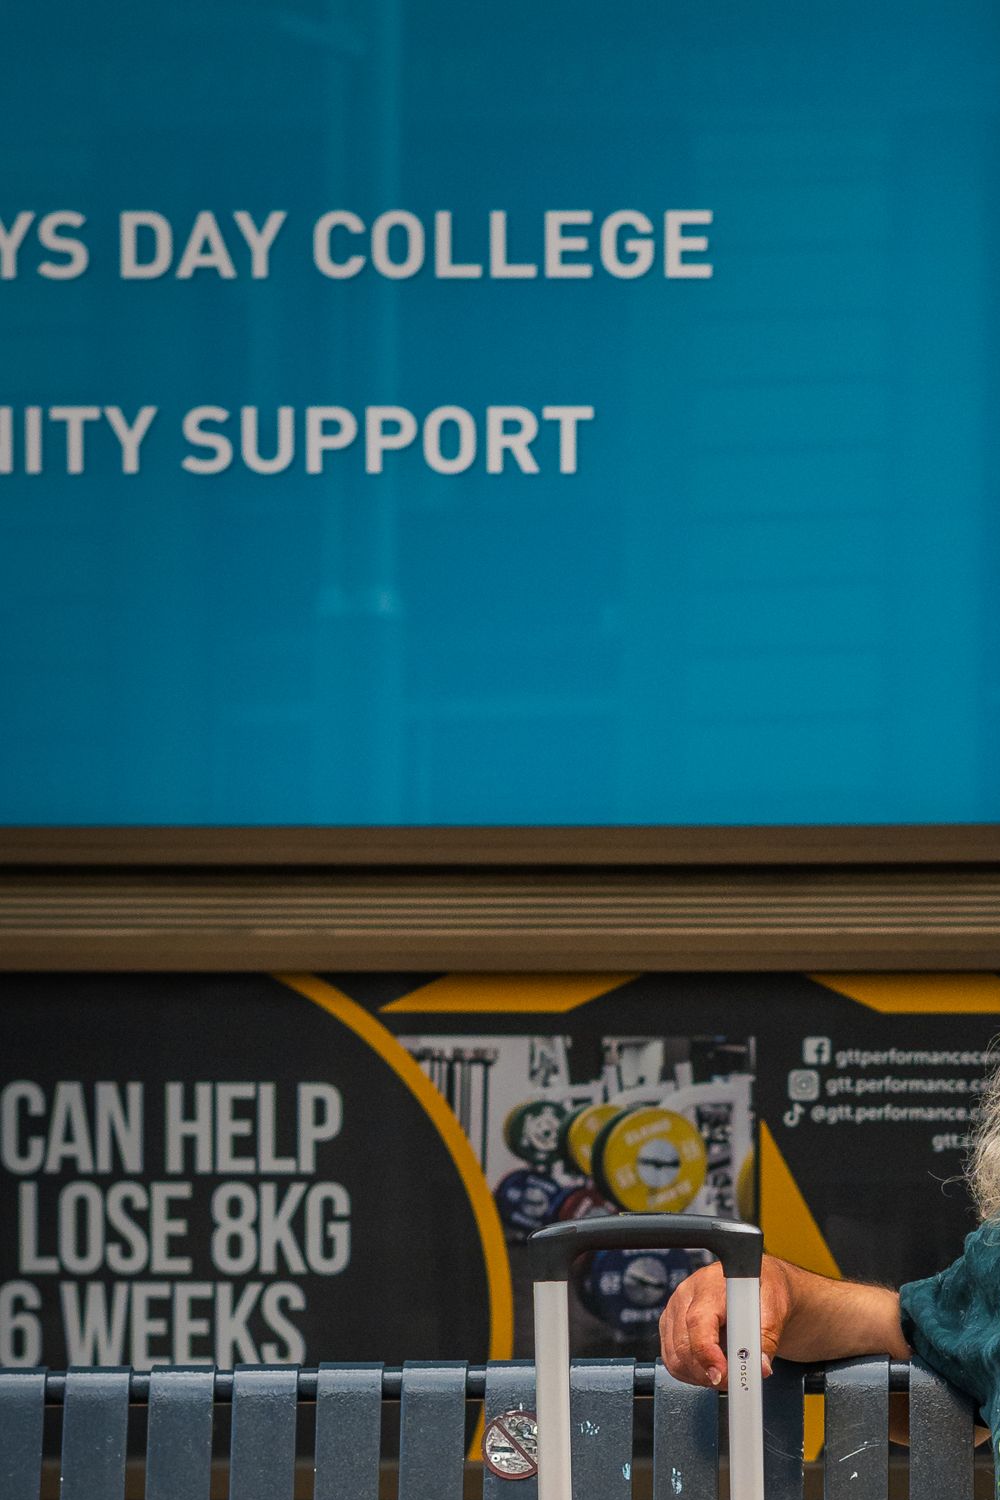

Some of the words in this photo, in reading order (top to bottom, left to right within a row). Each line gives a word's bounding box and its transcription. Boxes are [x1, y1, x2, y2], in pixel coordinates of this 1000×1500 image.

[119, 211, 288, 279] DAY
[312, 209, 714, 279] COLLEGE
[181, 405, 595, 475] SUPPORT
[1, 1080, 145, 1175] CAN
[165, 1081, 344, 1175] HELP
[18, 1180, 194, 1275] LOSE
[210, 1180, 352, 1276] 8KG
[0, 1280, 43, 1368] 6
[60, 1280, 307, 1370] WEEKS
